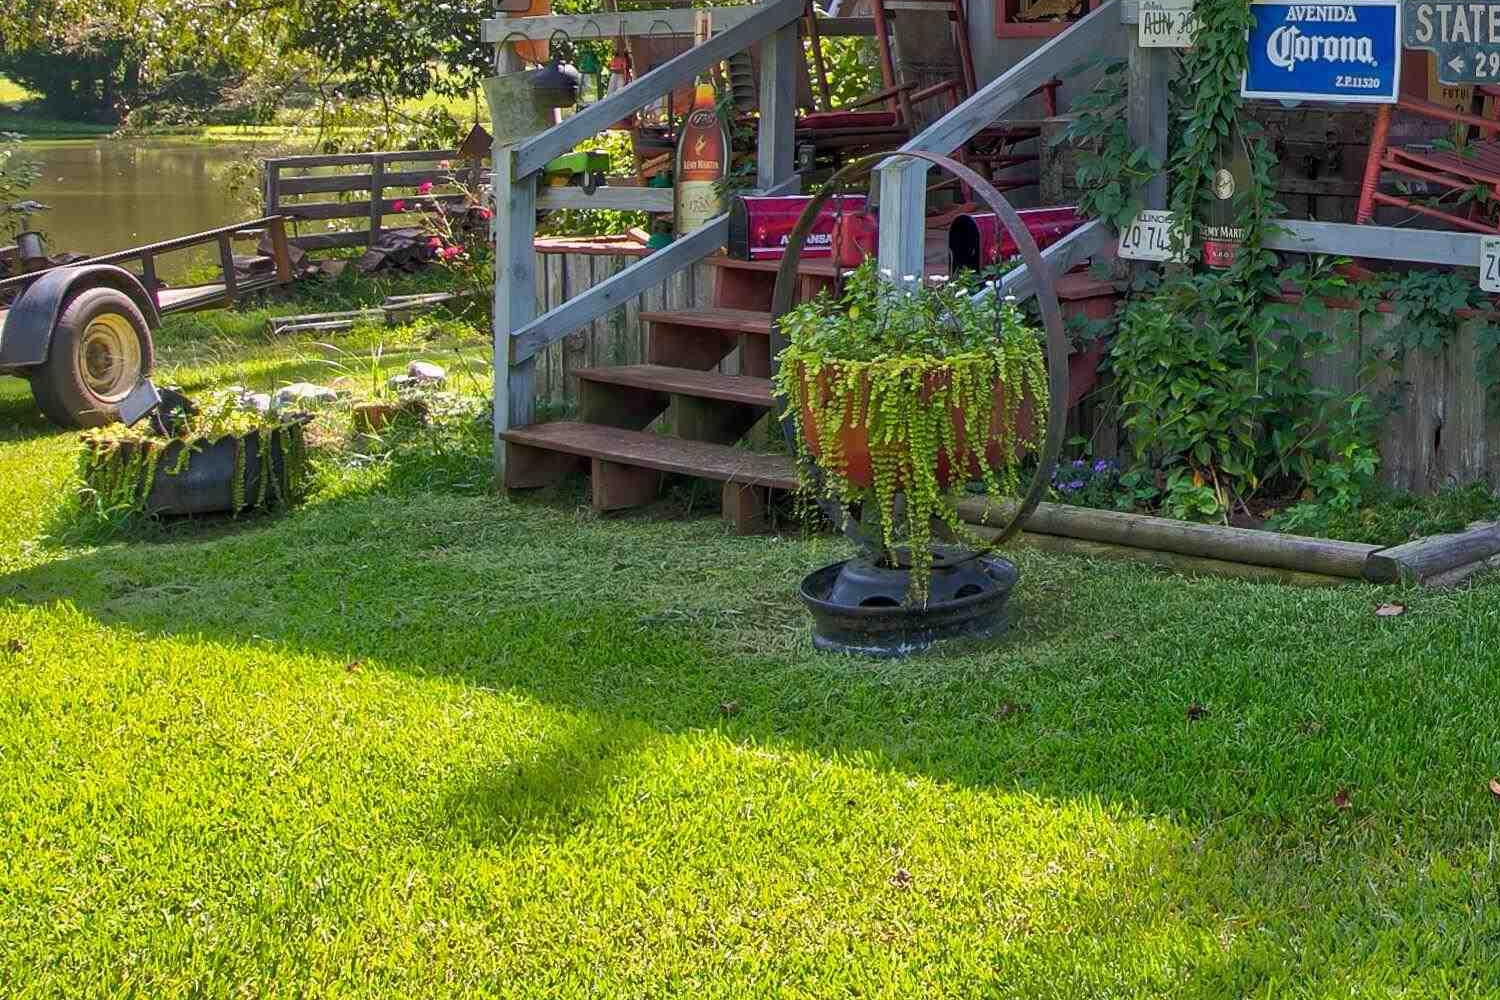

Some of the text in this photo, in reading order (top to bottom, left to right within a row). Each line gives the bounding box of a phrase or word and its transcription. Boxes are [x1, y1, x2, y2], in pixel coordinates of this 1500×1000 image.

[1285, 5, 1358, 22] AVENIDA
[1267, 25, 1375, 72] Corona
[1137, 214, 1172, 223] LLINOI
[1148, 227, 1170, 251] 74
[1220, 226, 1246, 239] MART
